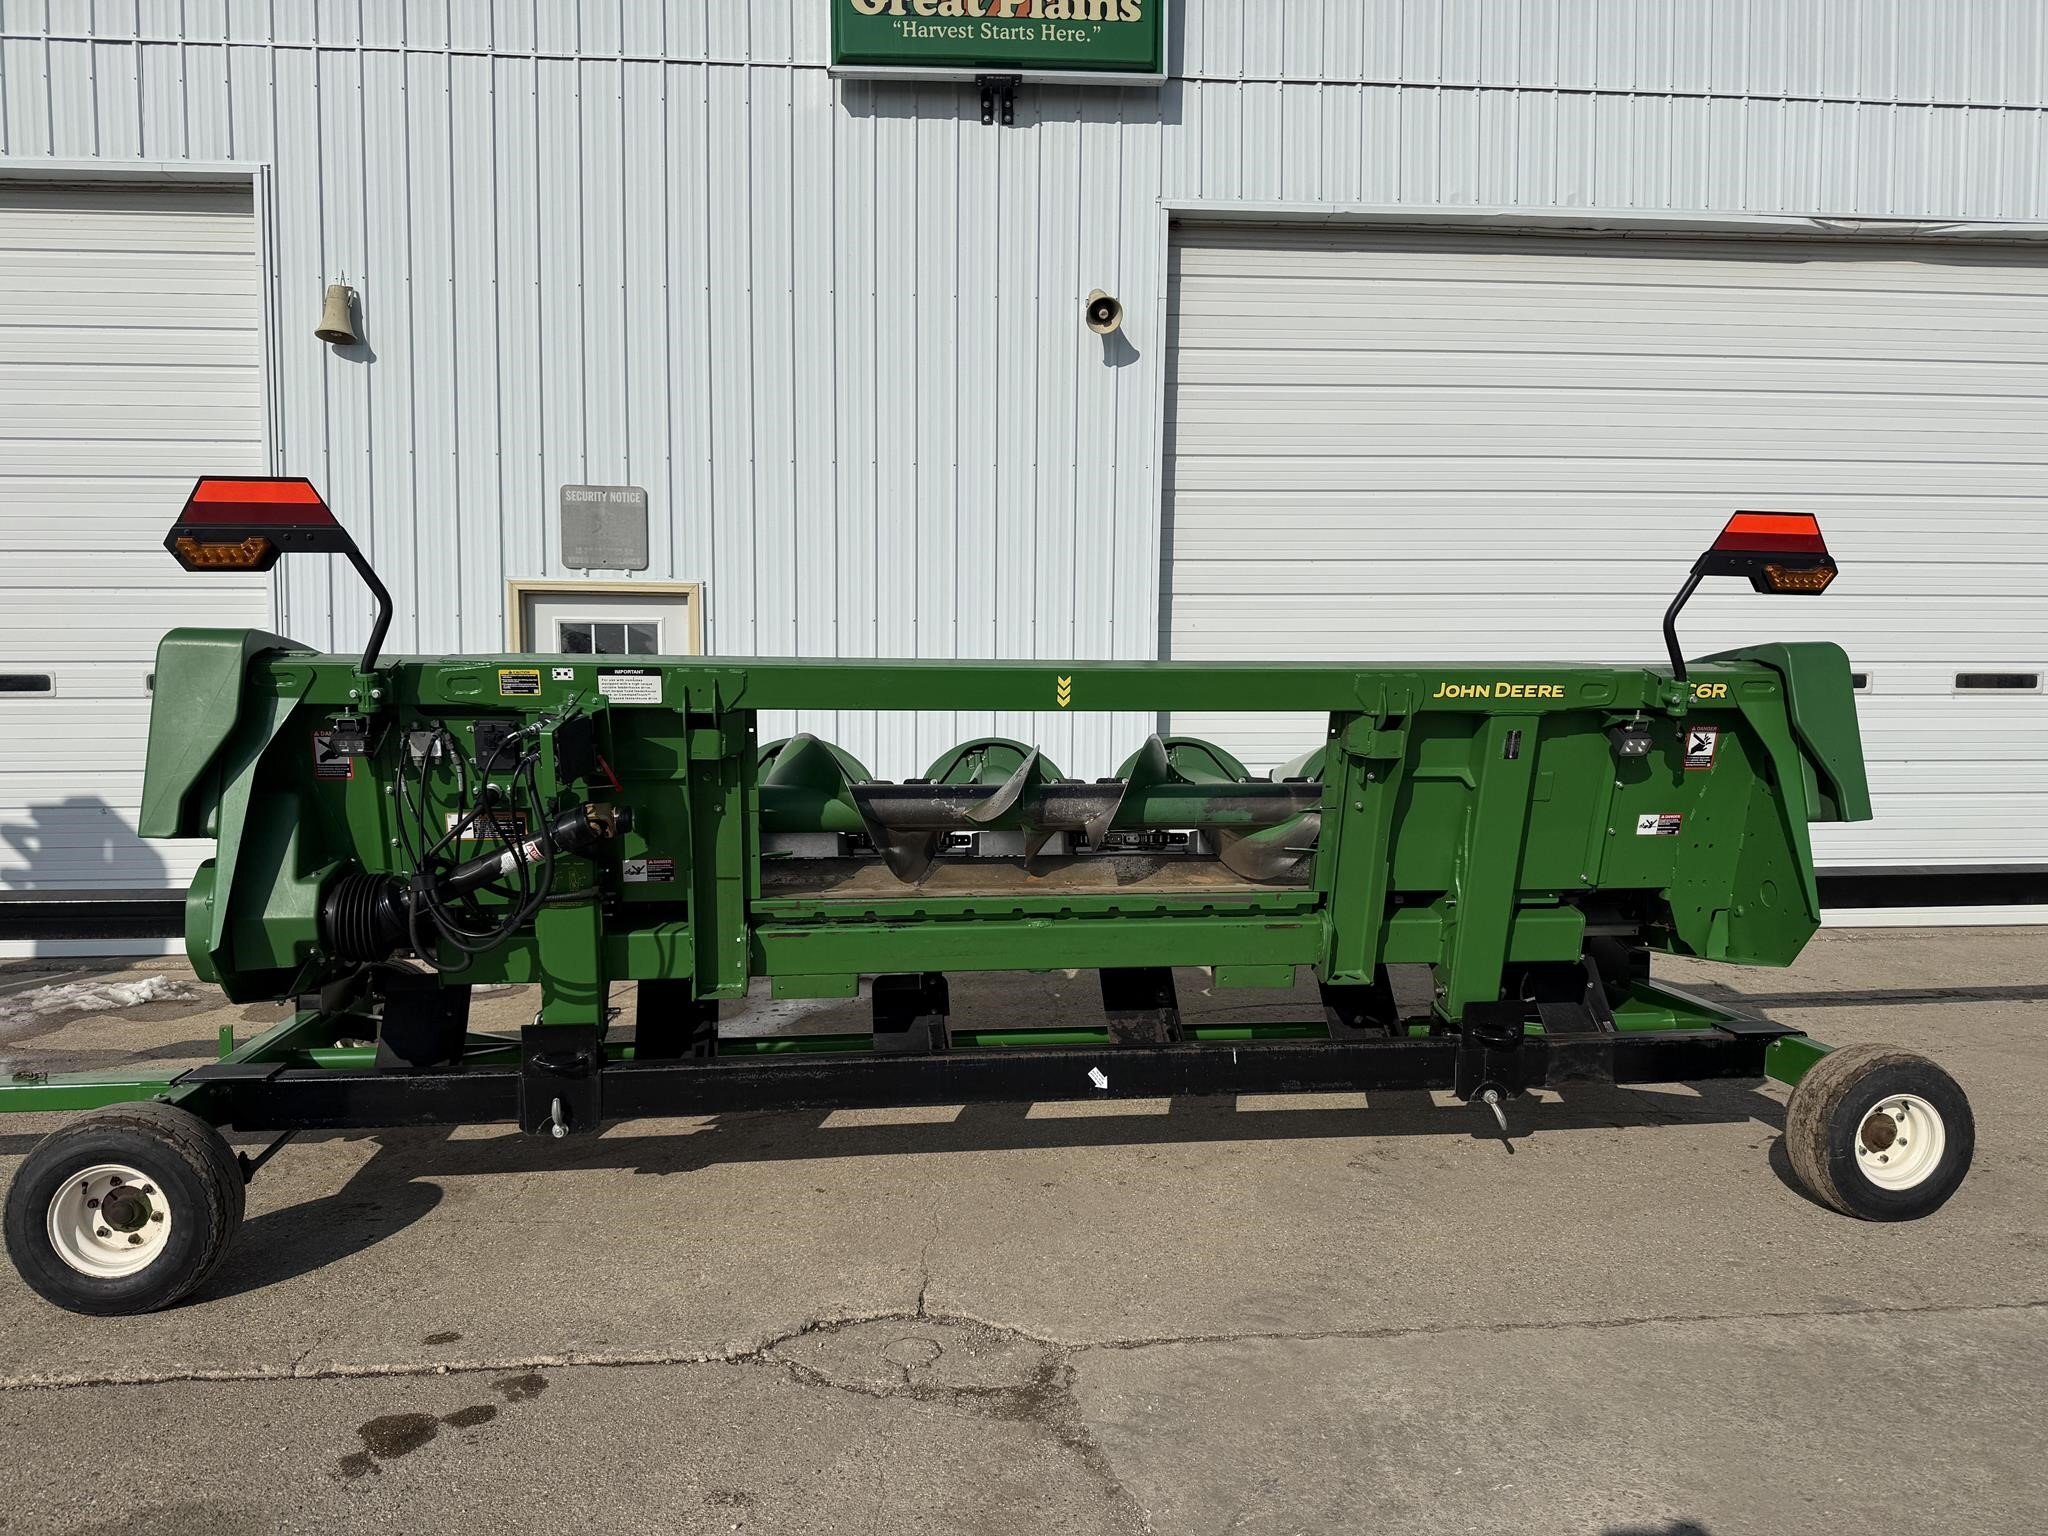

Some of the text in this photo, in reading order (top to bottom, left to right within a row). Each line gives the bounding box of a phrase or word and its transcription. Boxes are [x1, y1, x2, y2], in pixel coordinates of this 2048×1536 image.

[893, 20, 1101, 42] “Harvest Starts Here.”
[565, 490, 641, 503] SECURITY NOTICE
[1433, 682, 1565, 698] JOHN DEERE
